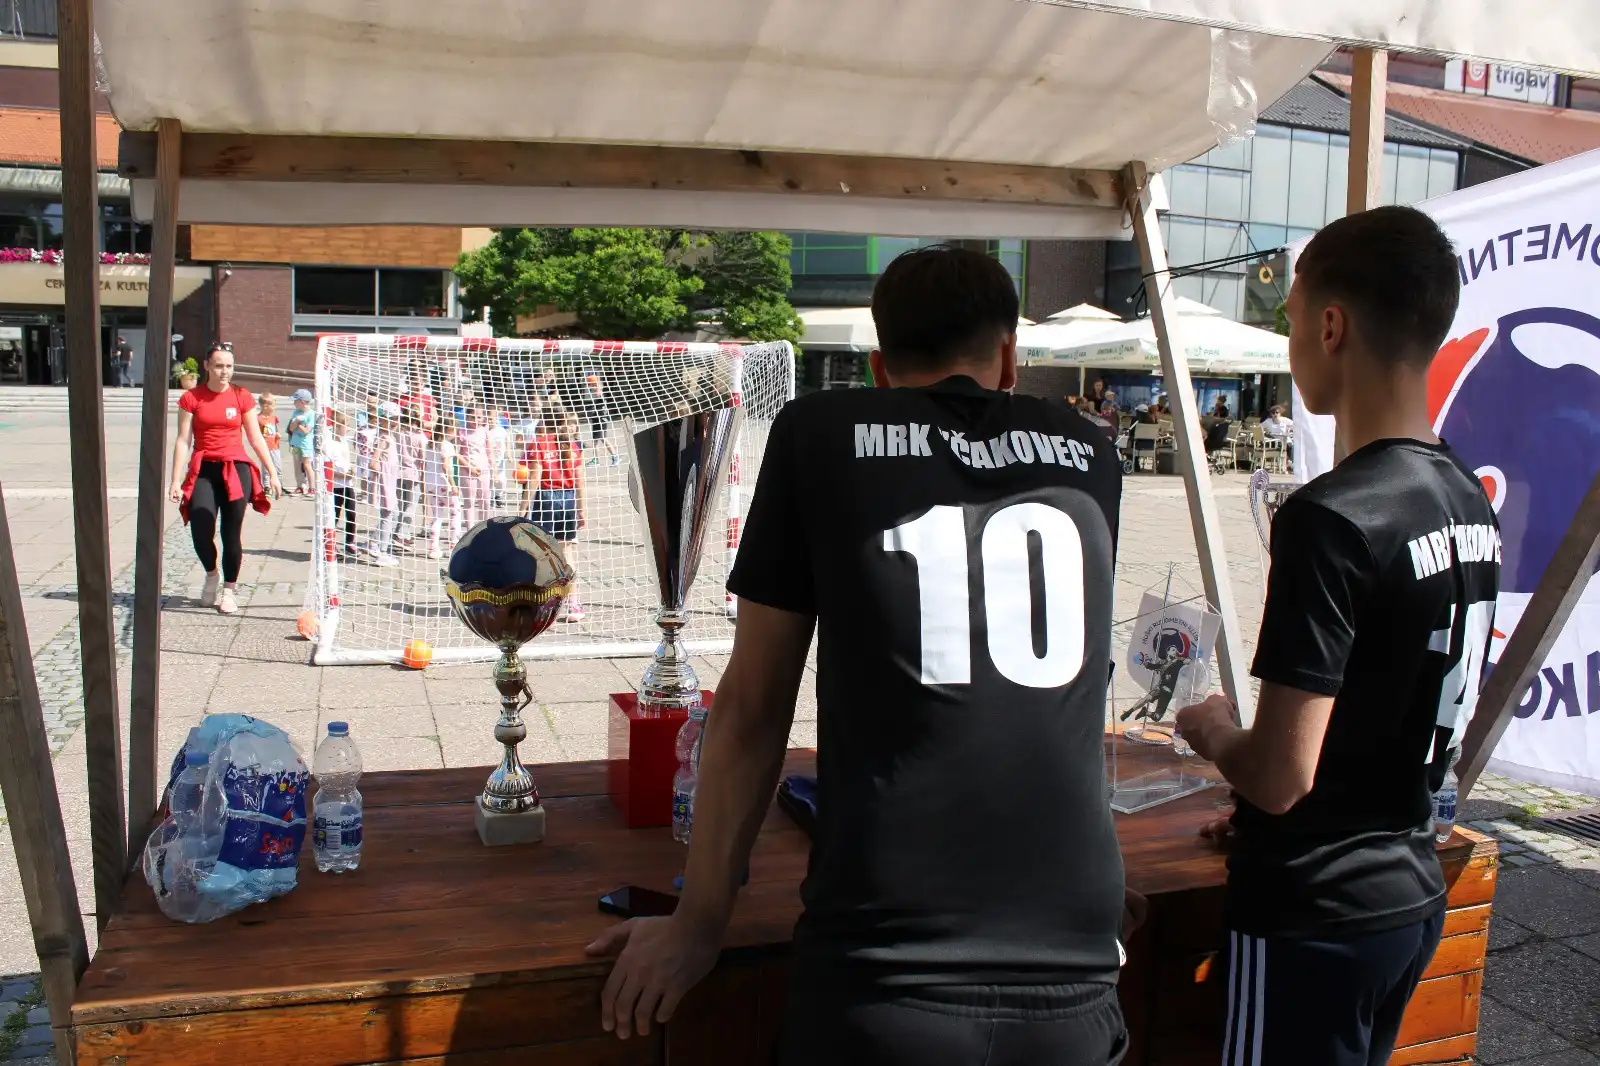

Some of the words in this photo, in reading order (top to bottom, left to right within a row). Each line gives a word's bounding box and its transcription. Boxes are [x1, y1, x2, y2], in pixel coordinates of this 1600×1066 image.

[1496, 66, 1550, 92] triglav
[854, 422, 933, 458] MRK
[883, 502, 1086, 689] 10
